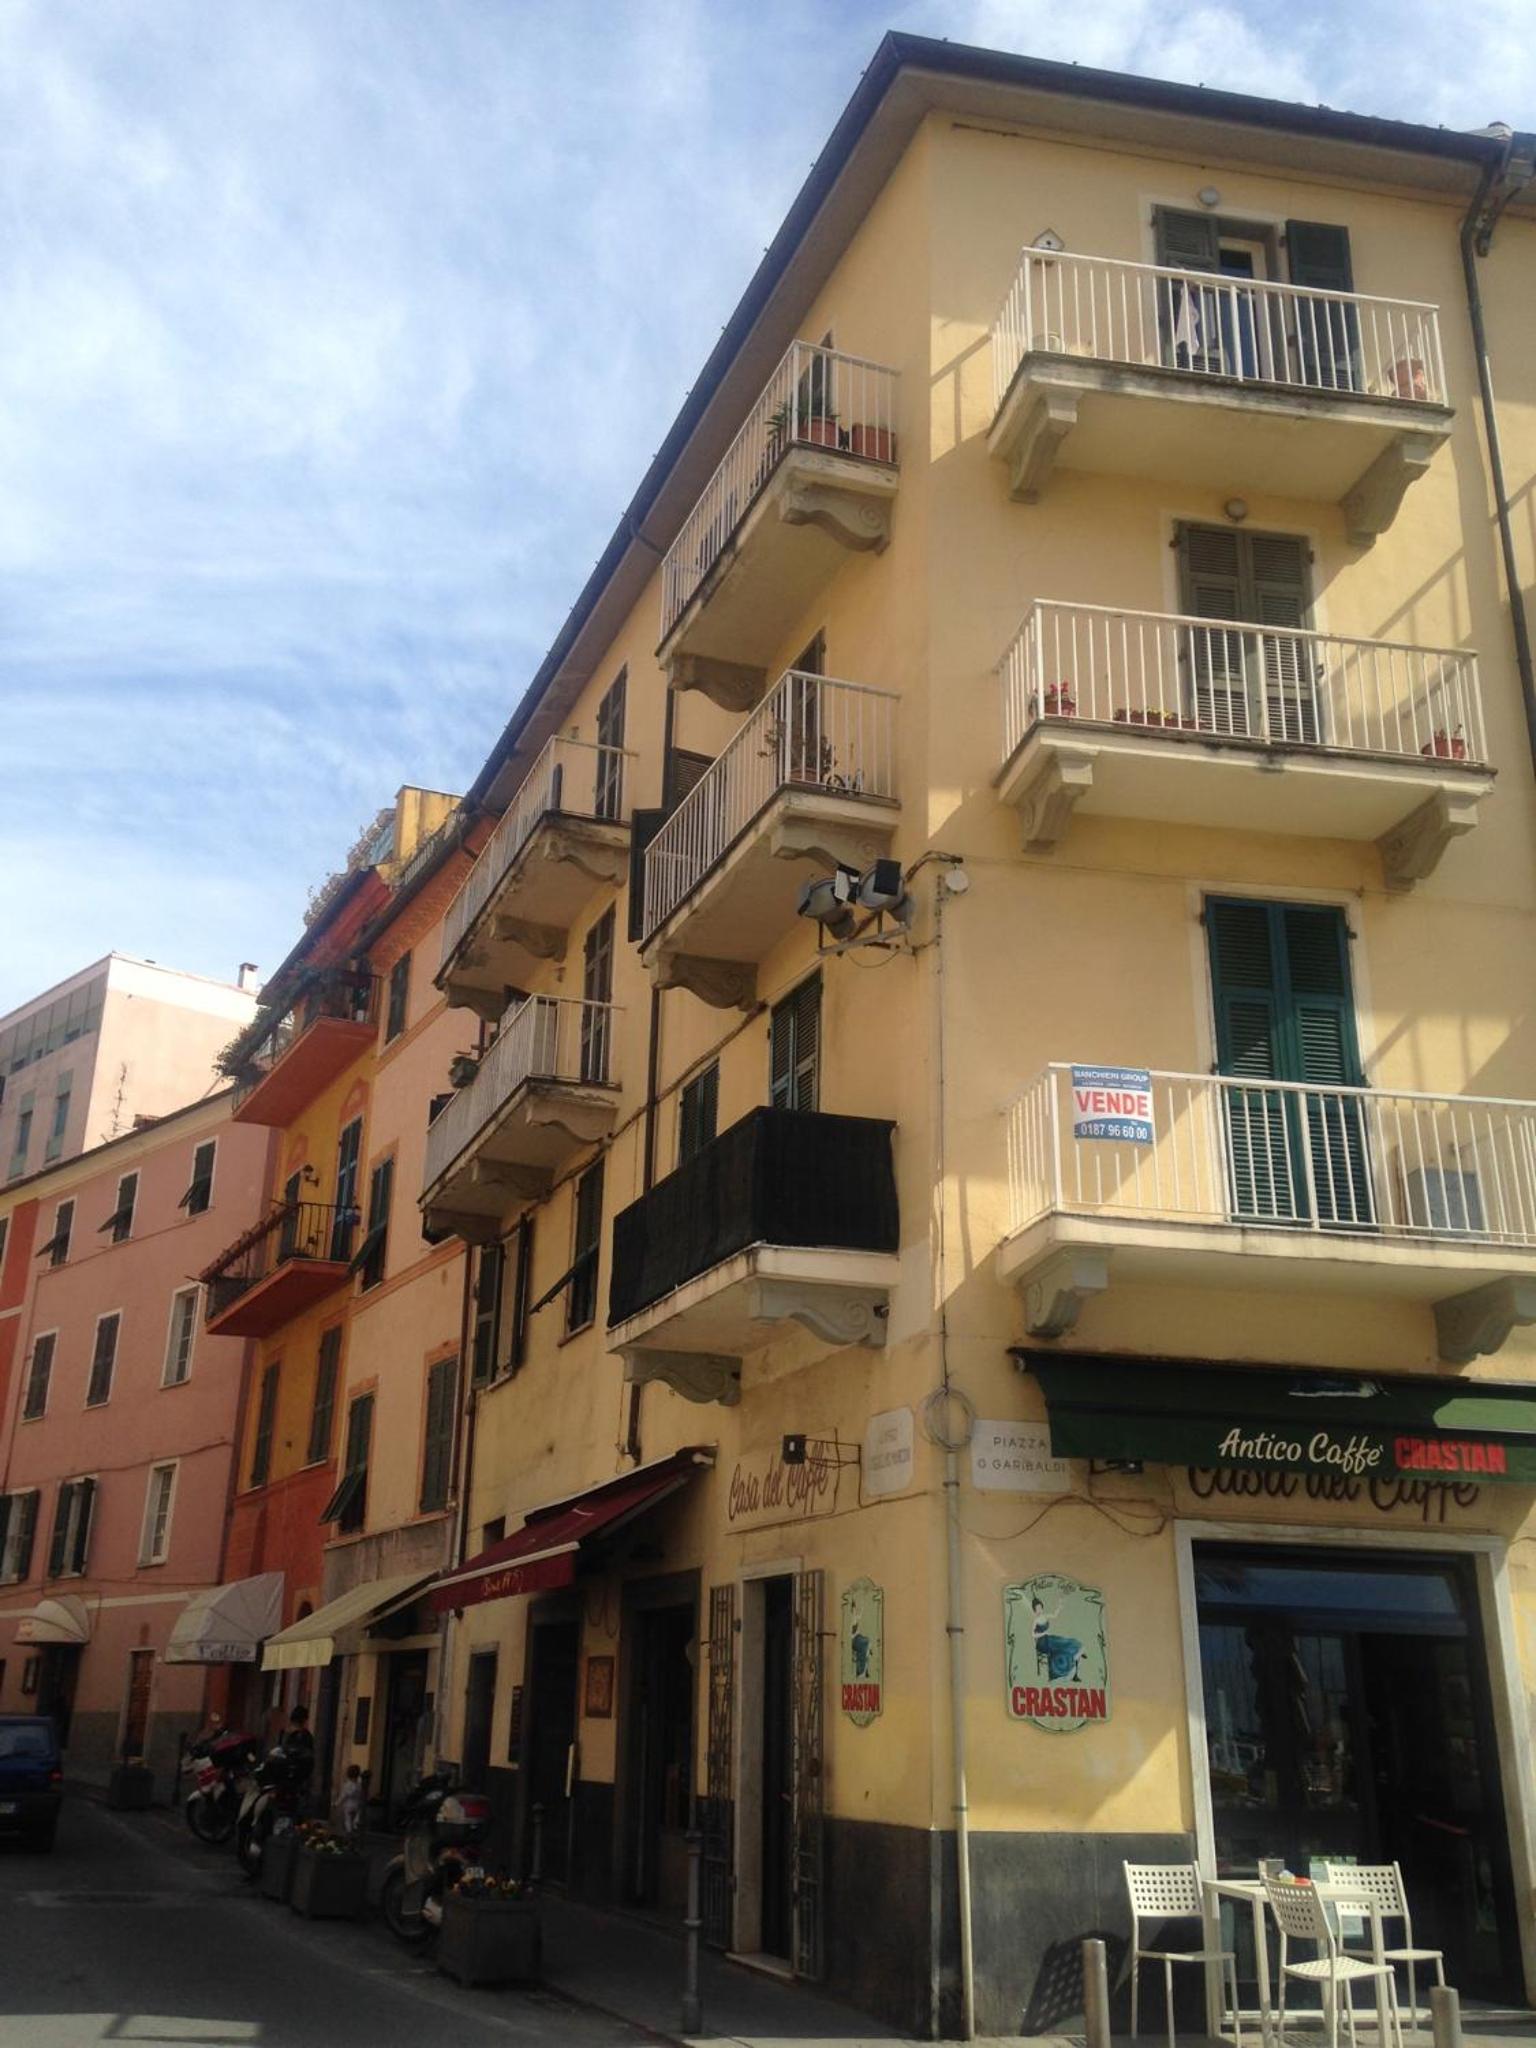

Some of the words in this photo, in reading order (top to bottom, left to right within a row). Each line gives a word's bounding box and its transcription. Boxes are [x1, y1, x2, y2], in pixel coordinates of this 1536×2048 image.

[1075, 1090, 1149, 1117] VENDE
[1080, 1123, 1106, 1136] 0187
[1108, 1124, 1121, 1137] 96
[1122, 1126, 1135, 1138] 60
[1136, 1127, 1148, 1140] 00
[992, 1436, 1048, 1451] PIAZZA
[1218, 1428, 1301, 1462] Antico
[1393, 1437, 1506, 1473] CRASTAN
[991, 1458, 1067, 1473] GARIBALDI
[729, 1463, 759, 1521] Casa
[841, 1683, 881, 1713] CRASTAN
[1011, 1686, 1107, 1719] CRASTAN
